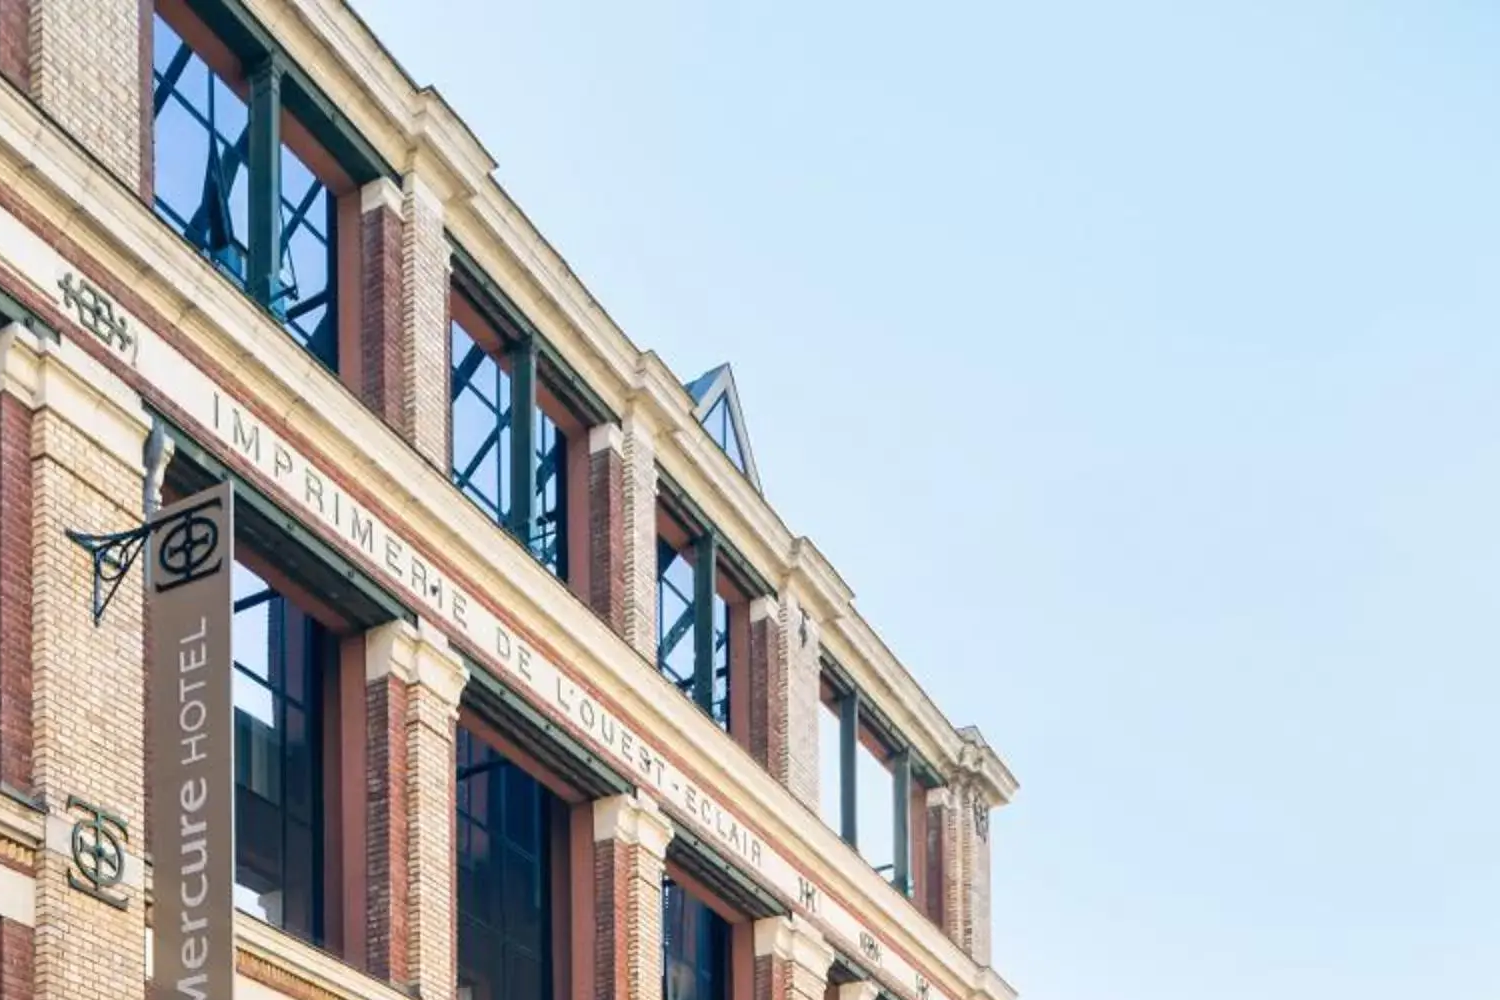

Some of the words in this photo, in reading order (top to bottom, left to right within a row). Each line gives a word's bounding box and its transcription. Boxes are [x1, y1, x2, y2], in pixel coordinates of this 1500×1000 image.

[213, 390, 468, 629] IMPRIMERIE
[496, 626, 532, 682] DE
[179, 616, 207, 765] HOTEL
